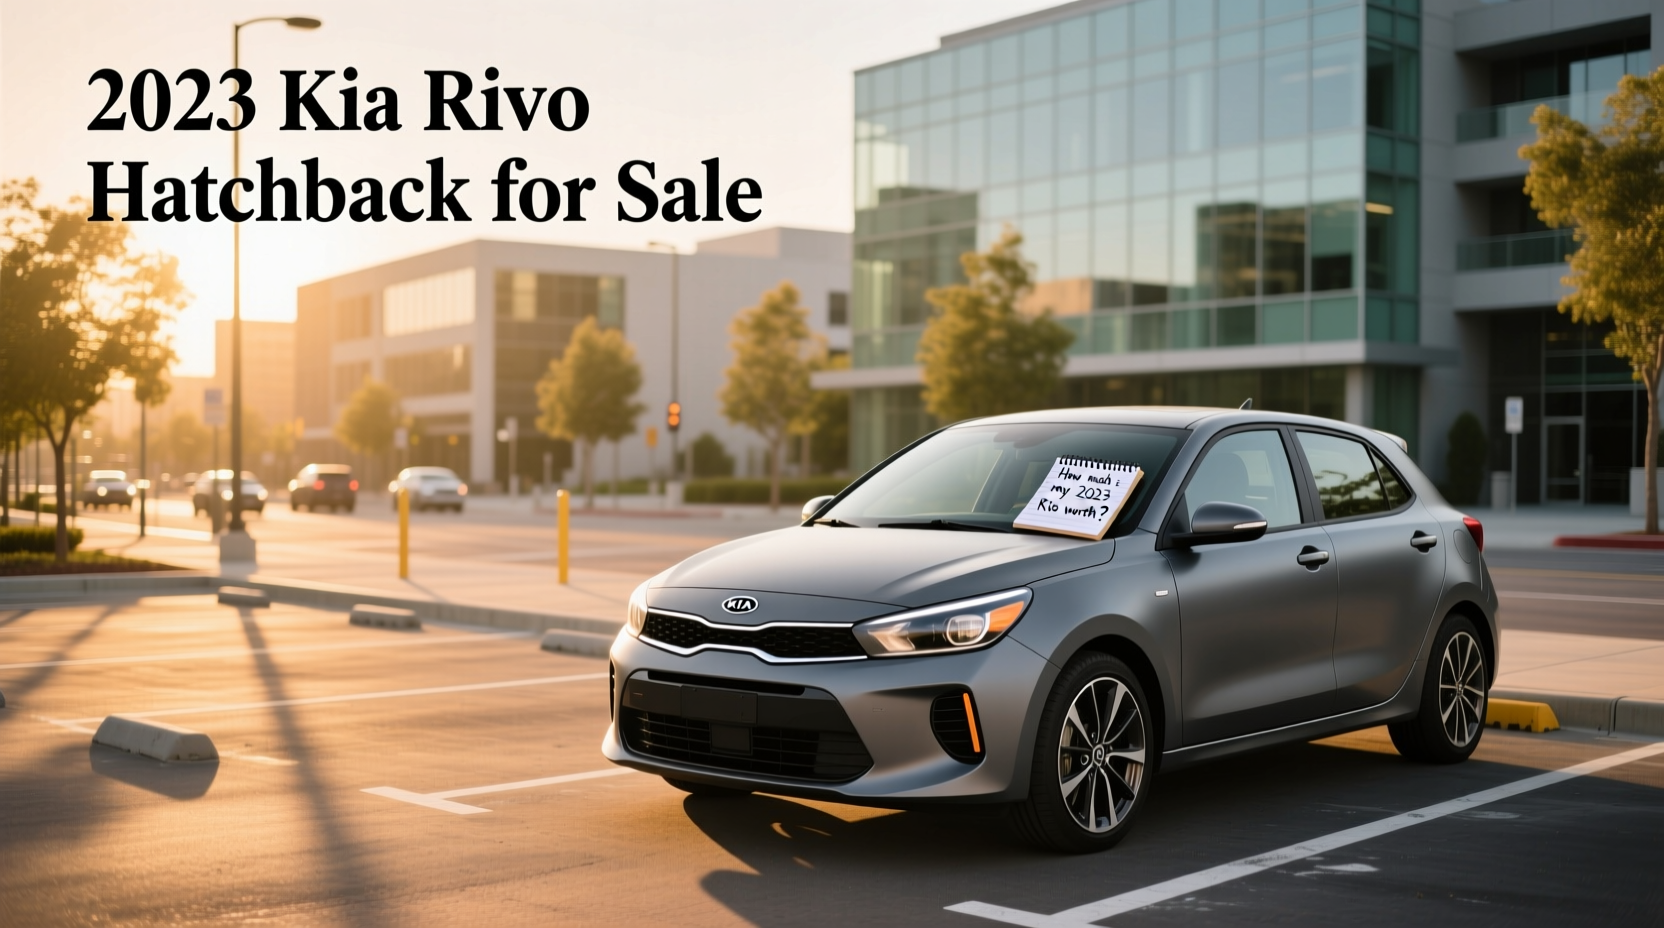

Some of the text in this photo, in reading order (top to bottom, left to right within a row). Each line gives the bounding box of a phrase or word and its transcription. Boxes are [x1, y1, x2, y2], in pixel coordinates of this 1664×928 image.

[1058, 467, 1081, 481] How
[1050, 485, 1111, 501] my 2023
[727, 599, 751, 610] KIA
